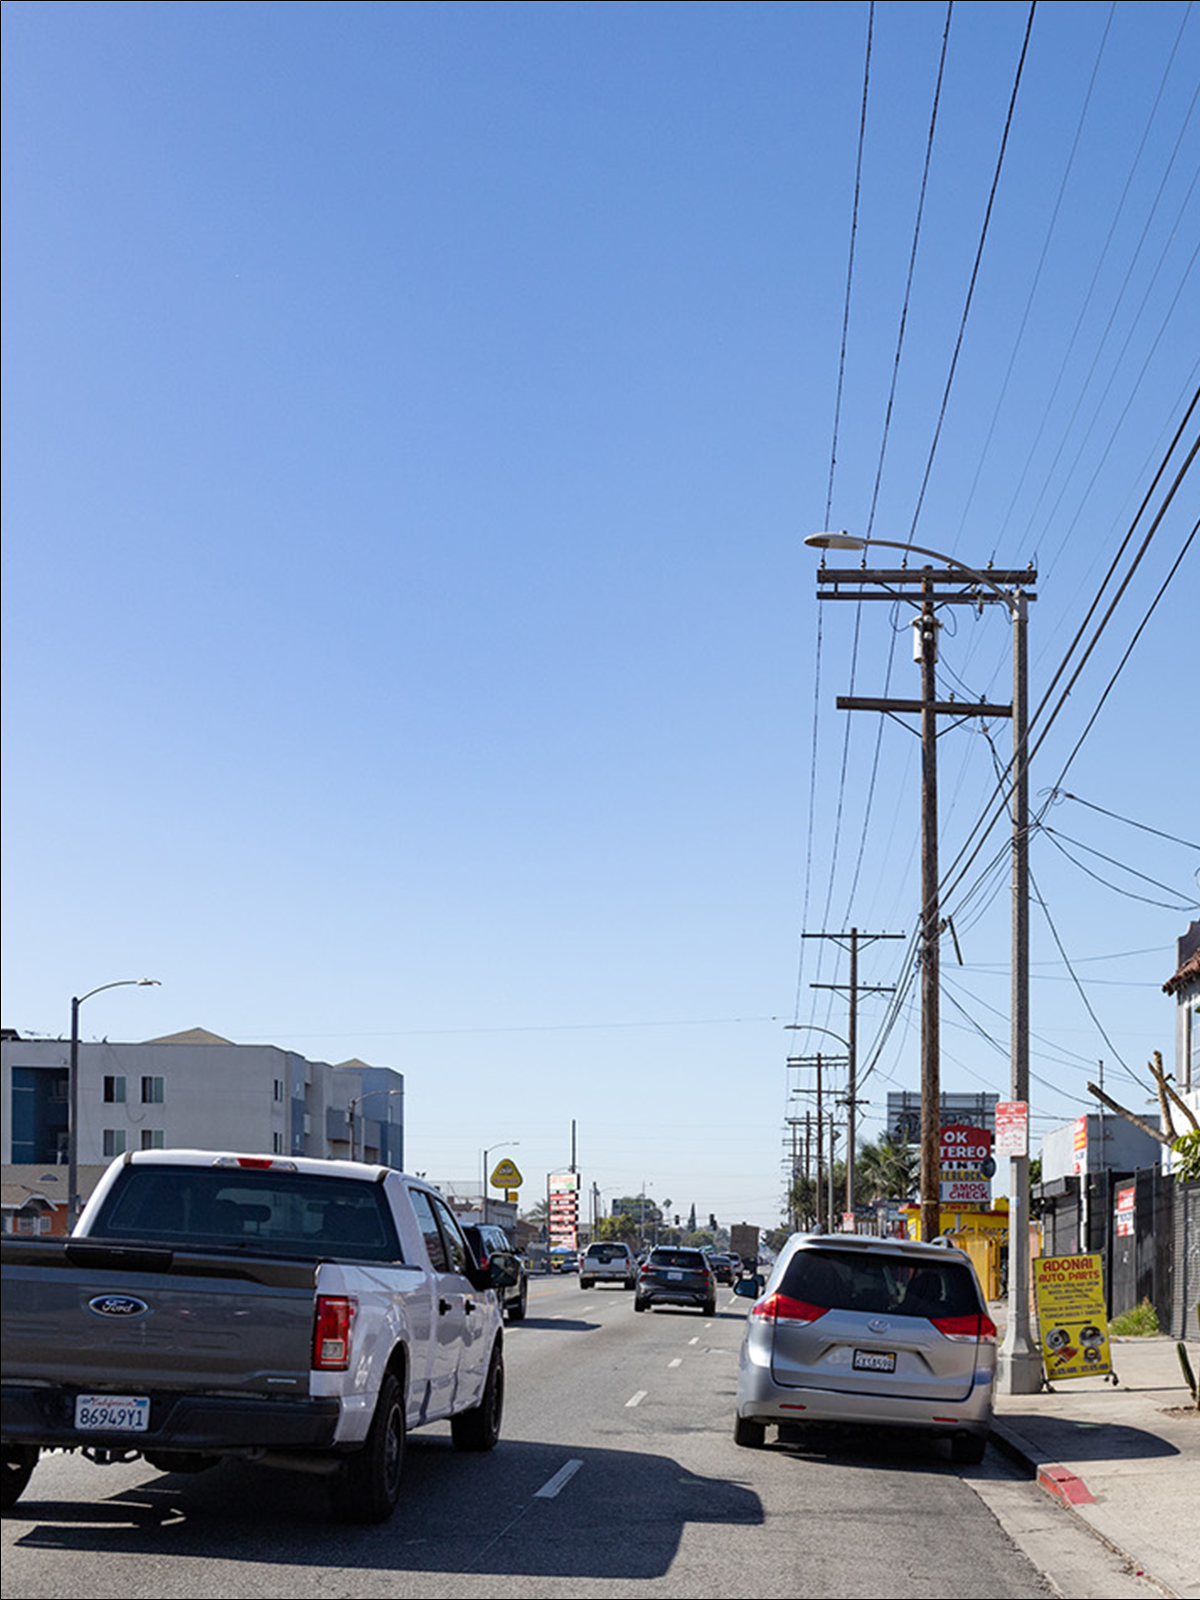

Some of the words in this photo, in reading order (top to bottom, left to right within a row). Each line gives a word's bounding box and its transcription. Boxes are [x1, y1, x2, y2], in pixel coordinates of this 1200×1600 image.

[943, 1131, 968, 1143] OK
[939, 1146, 988, 1158] TEREO
[952, 1183, 986, 1192] SMOG
[948, 1191, 989, 1200] CHECK
[1043, 1258, 1093, 1272] ADONAI
[1038, 1273, 1066, 1283] AUTO
[1068, 1270, 1100, 1281] PARTS
[102, 1299, 134, 1313] Ford
[80, 1407, 143, 1427] 86949Y1
